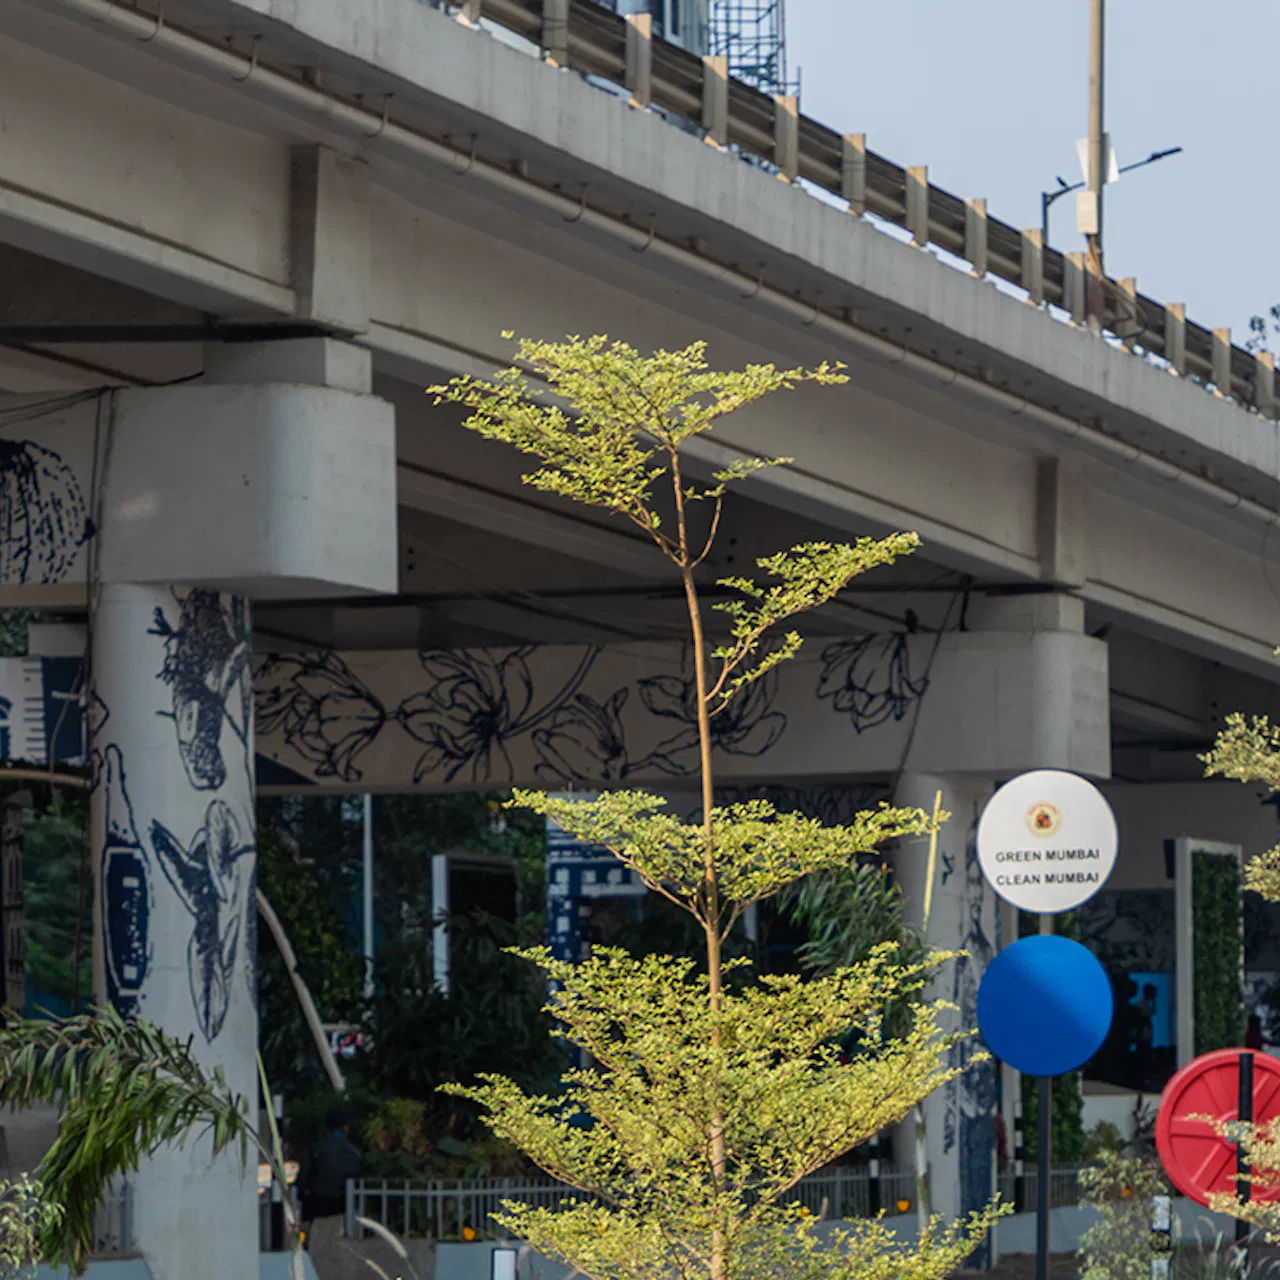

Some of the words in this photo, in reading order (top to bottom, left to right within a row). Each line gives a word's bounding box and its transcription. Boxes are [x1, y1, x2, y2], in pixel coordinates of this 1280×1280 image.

[995, 850, 1042, 863] GREEN
[1045, 848, 1100, 861] MUMBAI
[995, 873, 1041, 886] CLEAN
[1044, 871, 1099, 884] MUMBAI
